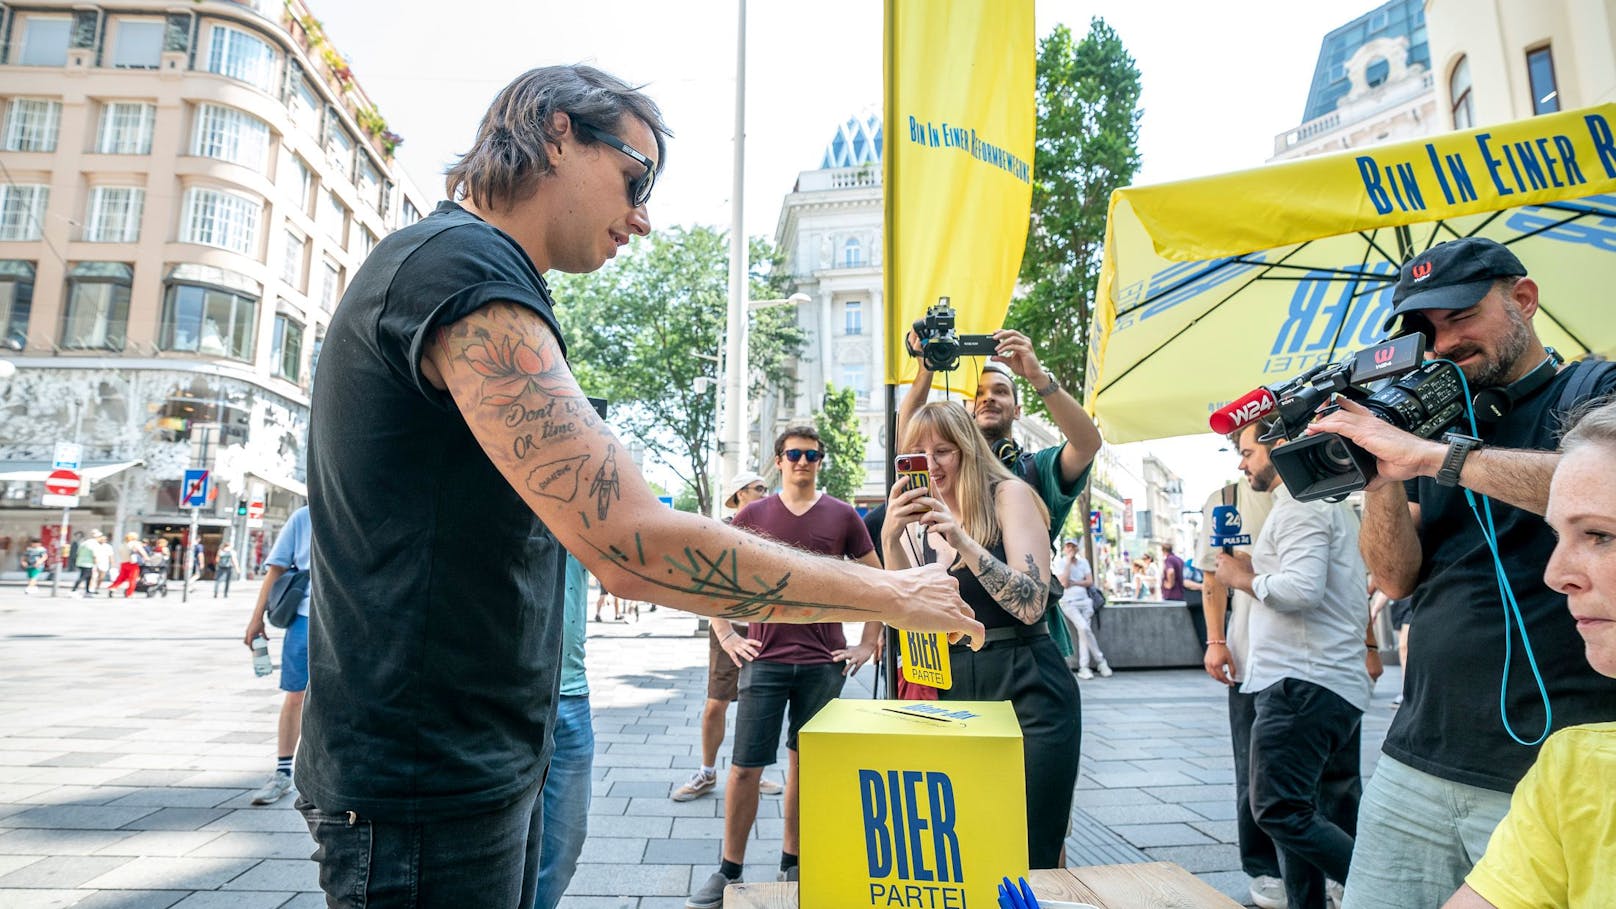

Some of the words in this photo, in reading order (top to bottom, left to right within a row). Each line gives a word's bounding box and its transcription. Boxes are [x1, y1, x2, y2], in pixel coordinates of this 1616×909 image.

[1355, 156, 1427, 216] BIN
[1425, 143, 1478, 206] IN
[1475, 133, 1587, 197] EINER
[1228, 394, 1273, 426] W24
[541, 420, 576, 440] time
[1225, 511, 1241, 528] 24
[1223, 537, 1240, 545] PULS
[907, 631, 942, 671] BIER
[912, 668, 945, 685] PARTEI
[858, 769, 964, 883] BIER
[869, 883, 967, 909] PARTEI
